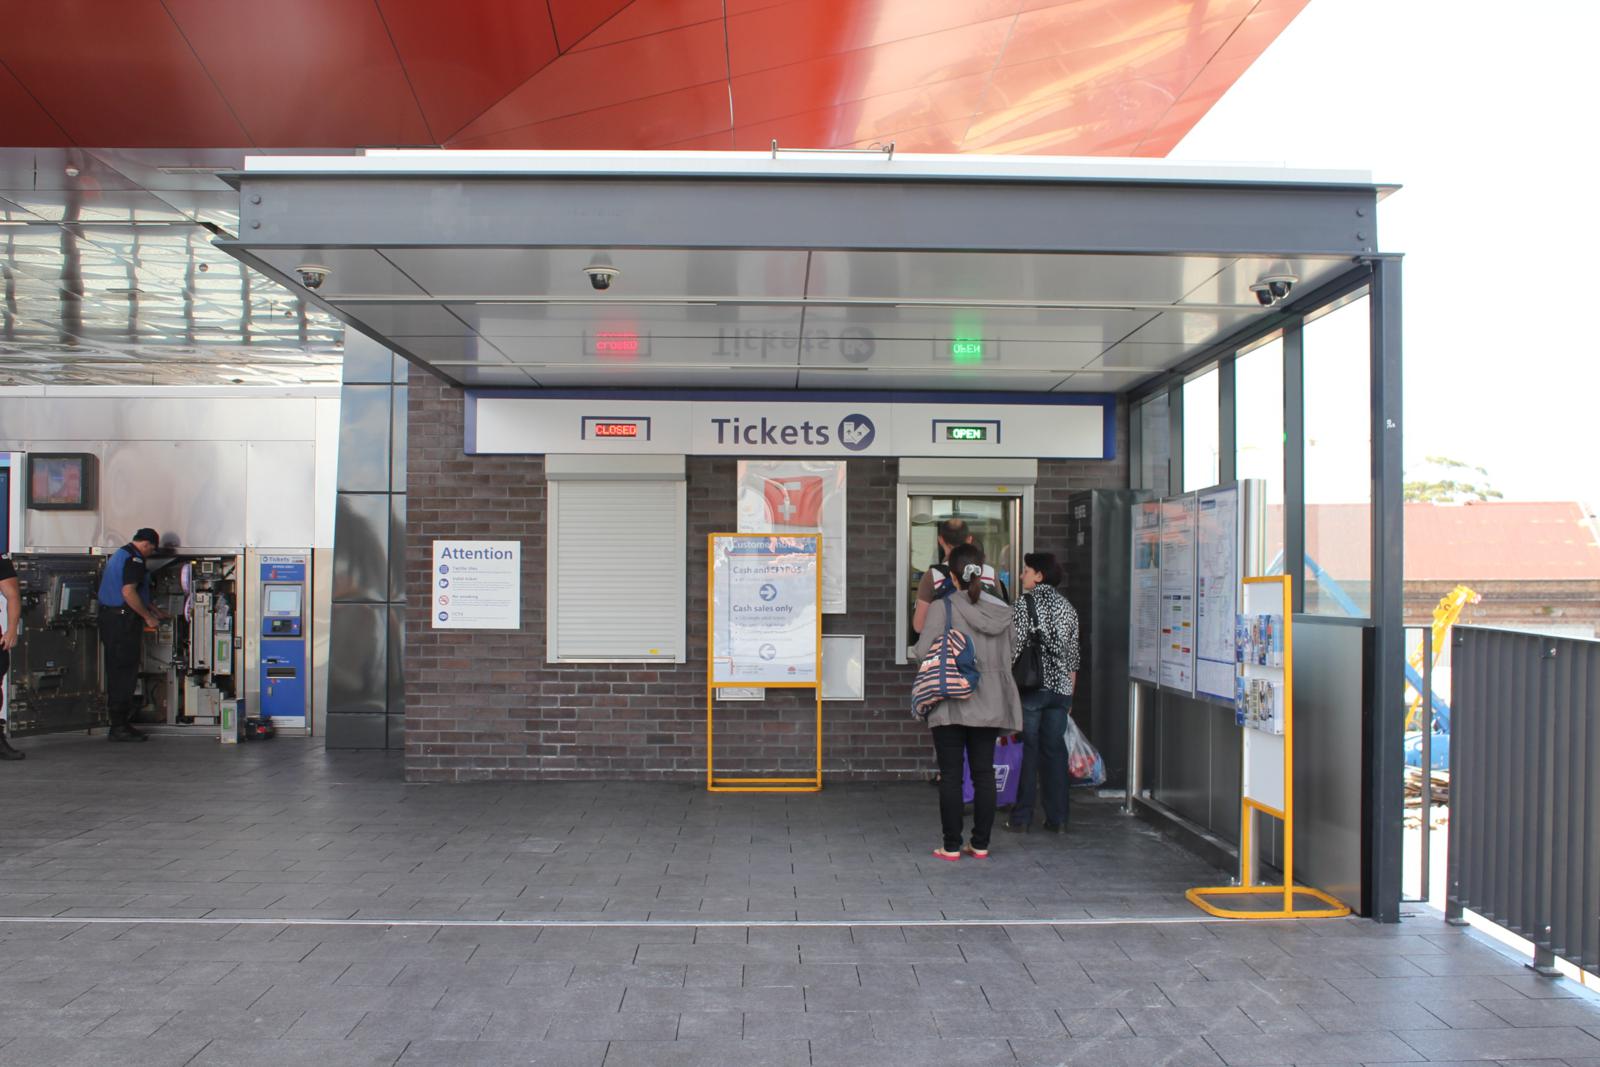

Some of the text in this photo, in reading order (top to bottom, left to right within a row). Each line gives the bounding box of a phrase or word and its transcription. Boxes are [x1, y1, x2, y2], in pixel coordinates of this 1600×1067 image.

[595, 424, 637, 435] CLOSED
[711, 417, 830, 445] Tickets
[952, 428, 981, 439] OPEN
[441, 547, 513, 560] Attention
[733, 566, 752, 574] Cash
[754, 566, 768, 574] and
[733, 604, 793, 613] Cash sales only
